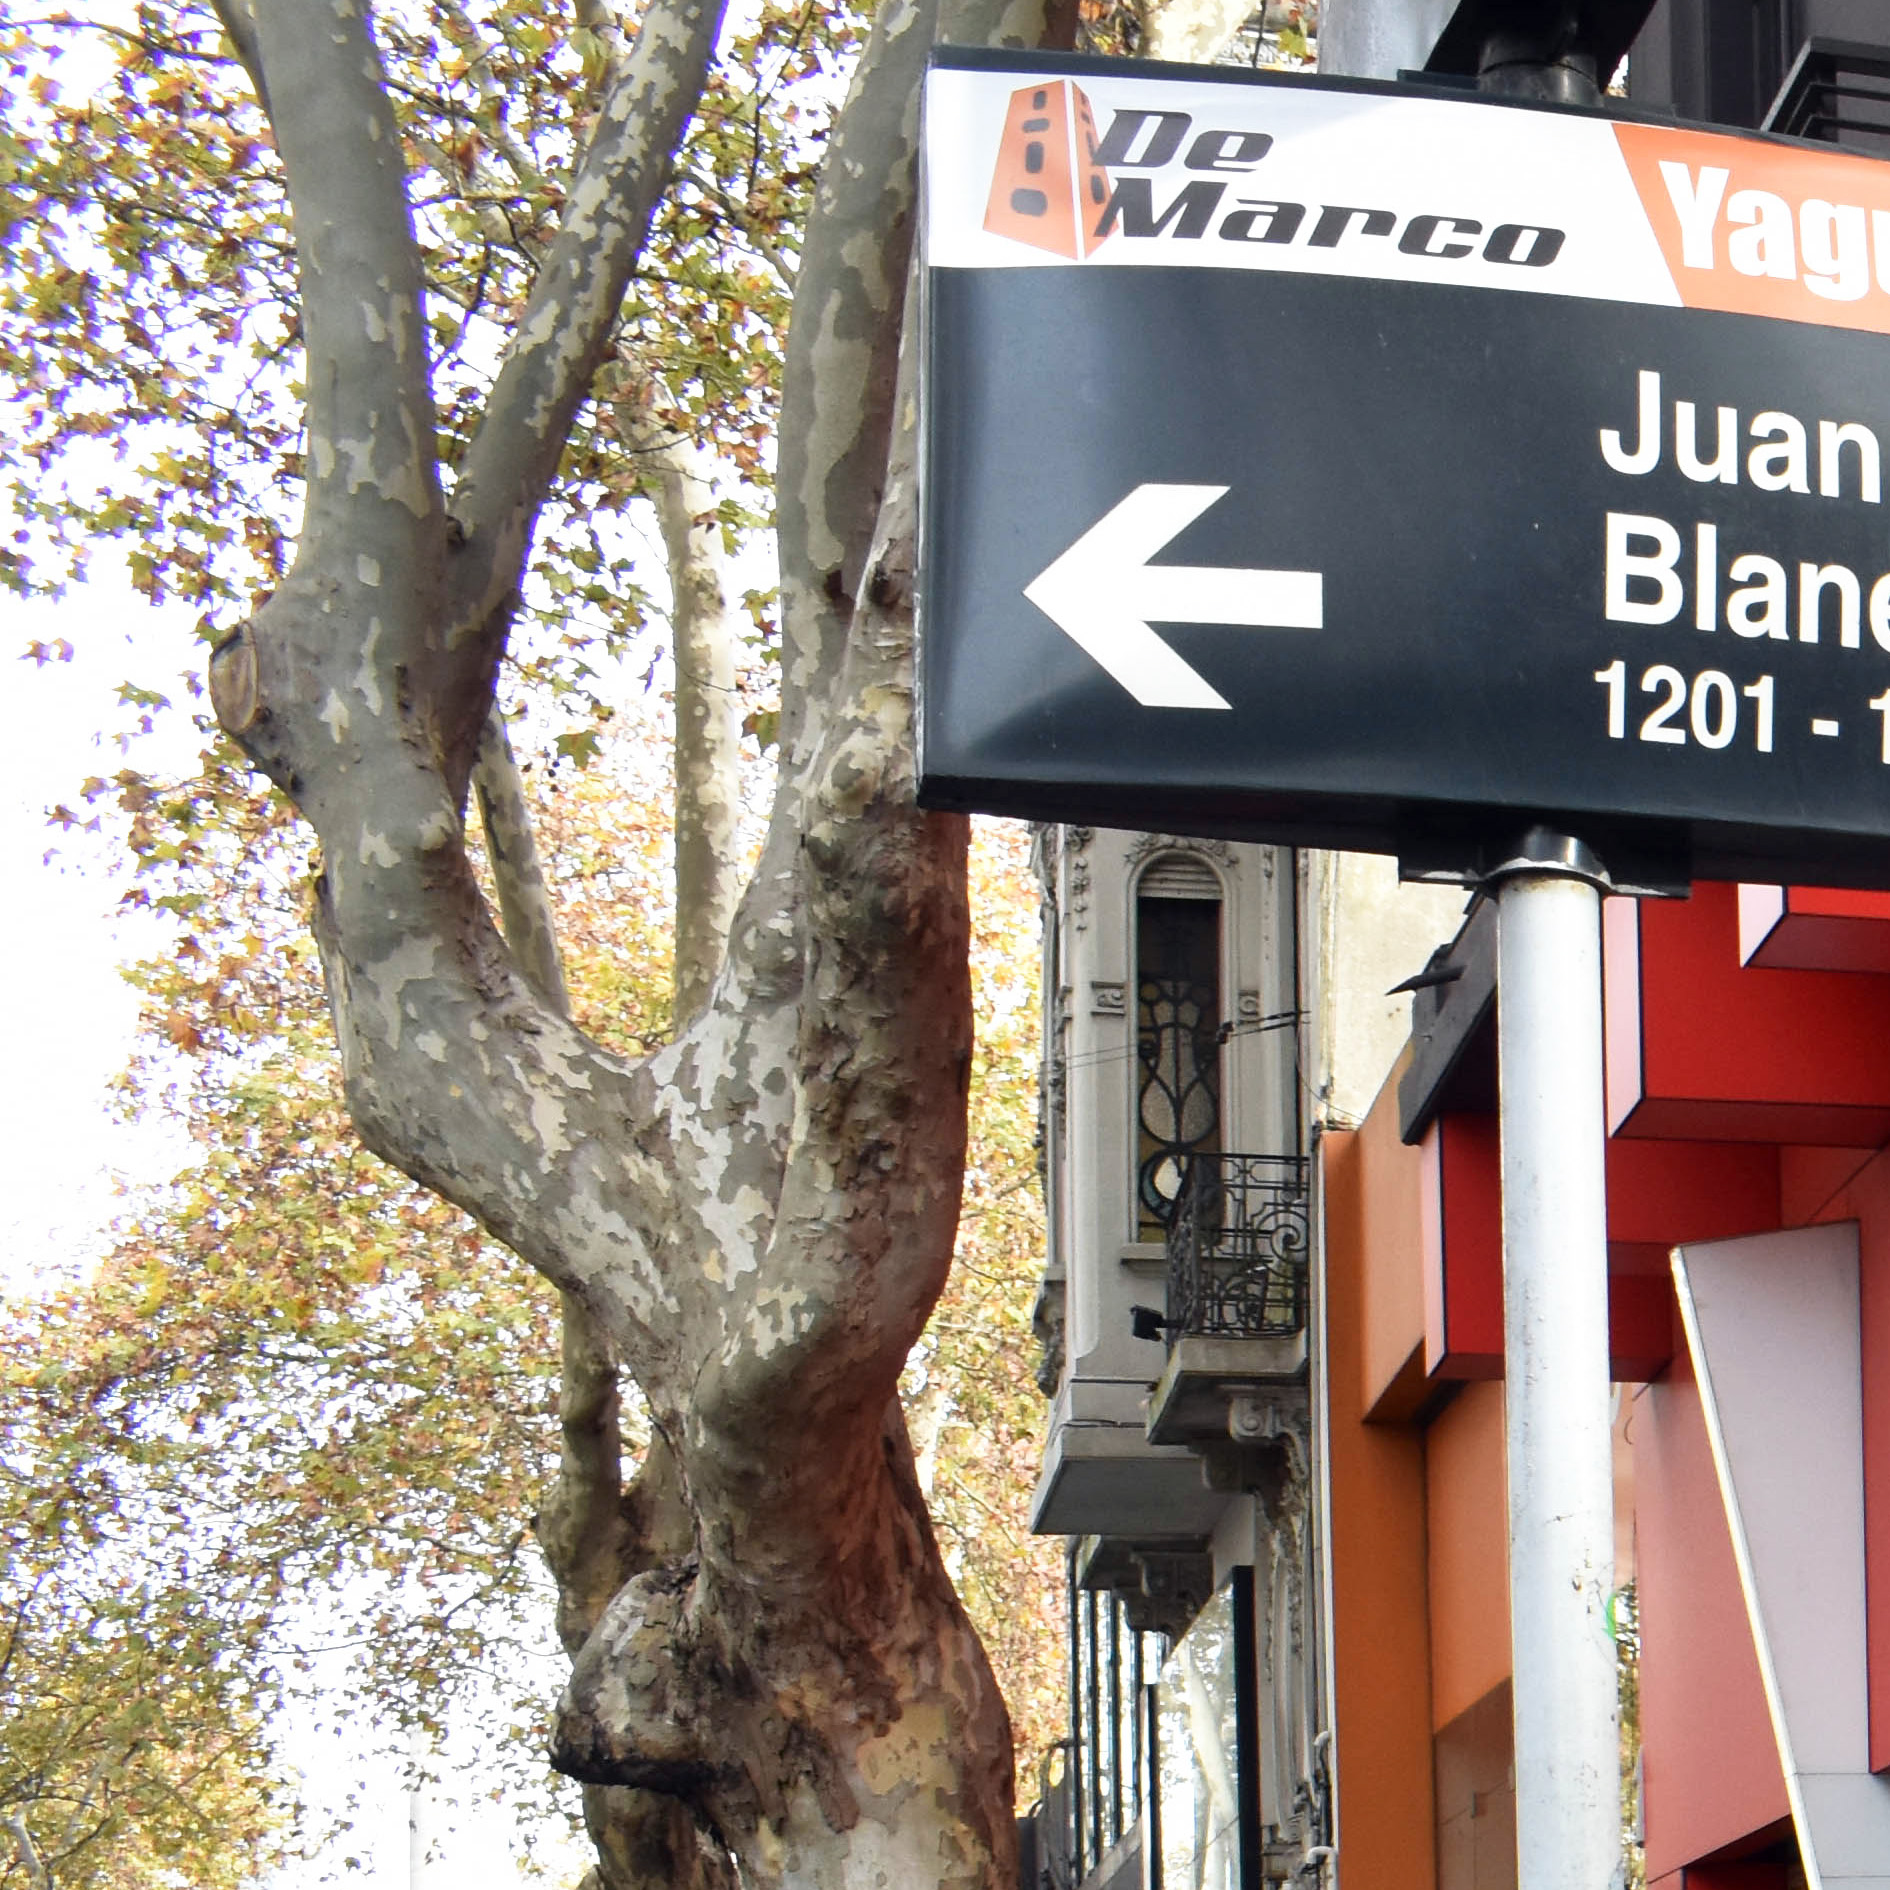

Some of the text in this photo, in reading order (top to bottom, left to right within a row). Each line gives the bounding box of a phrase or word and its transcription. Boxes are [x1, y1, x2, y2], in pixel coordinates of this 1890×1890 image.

[1098, 109, 1274, 173] De
[1094, 174, 1567, 268] Marco
[1599, 369, 1881, 504] Juan
[1595, 660, 1774, 753] 1201
